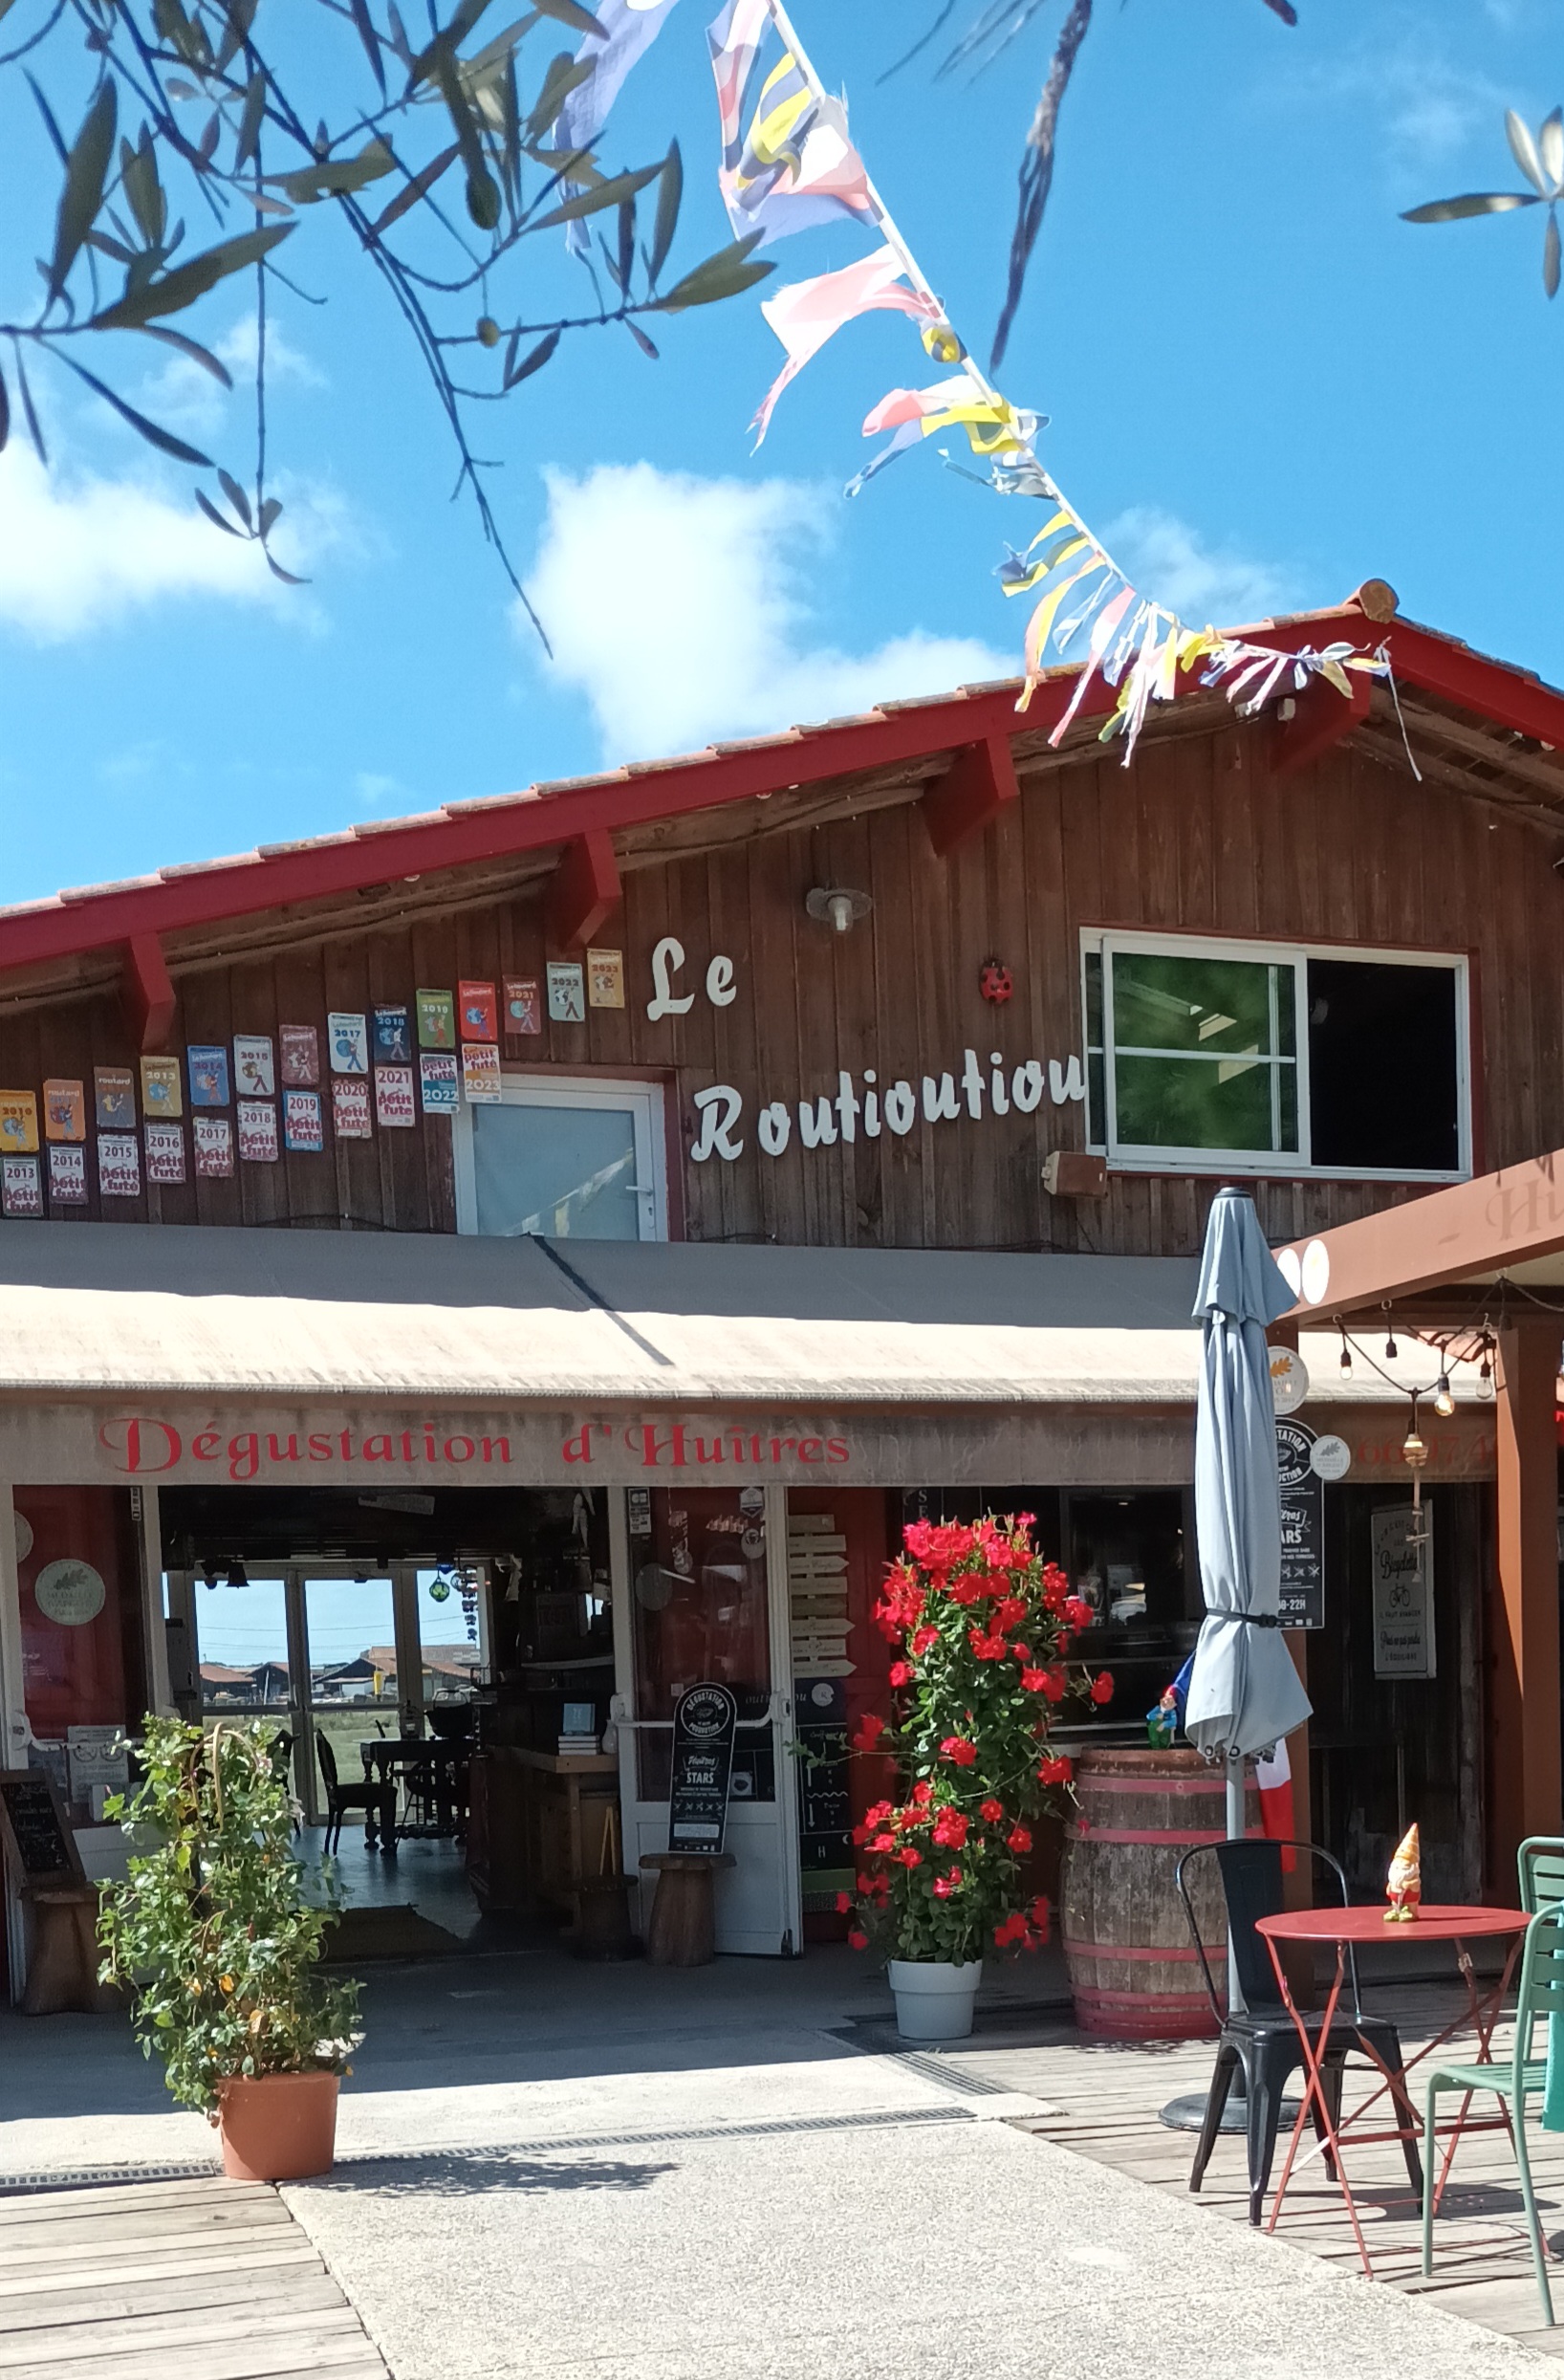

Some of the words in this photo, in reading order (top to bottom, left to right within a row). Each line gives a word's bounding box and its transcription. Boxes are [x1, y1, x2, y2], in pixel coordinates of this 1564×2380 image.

[552, 977, 579, 987] 2022
[646, 937, 737, 1021] Le
[378, 1016, 405, 1026] 2018
[335, 1029, 361, 1037] 2017
[241, 1051, 269, 1059] 2015
[423, 1059, 453, 1072] petit
[378, 1070, 409, 1084] 2021
[335, 1083, 367, 1097] 2020
[466, 1079, 500, 1090] 2023
[424, 1088, 459, 1101] 2022
[290, 1097, 316, 1110] 2019
[690, 1049, 1087, 1162] Routioutiou
[244, 1111, 271, 1124] 2018
[199, 1127, 227, 1140] 2017
[150, 1135, 180, 1147] 2016
[104, 1146, 132, 1158] 2015
[53, 1155, 82, 1167] 2014
[7, 1167, 35, 1179] 2013
[98, 1417, 514, 1481] Dégustation
[686, 1772, 714, 1784] STARS
